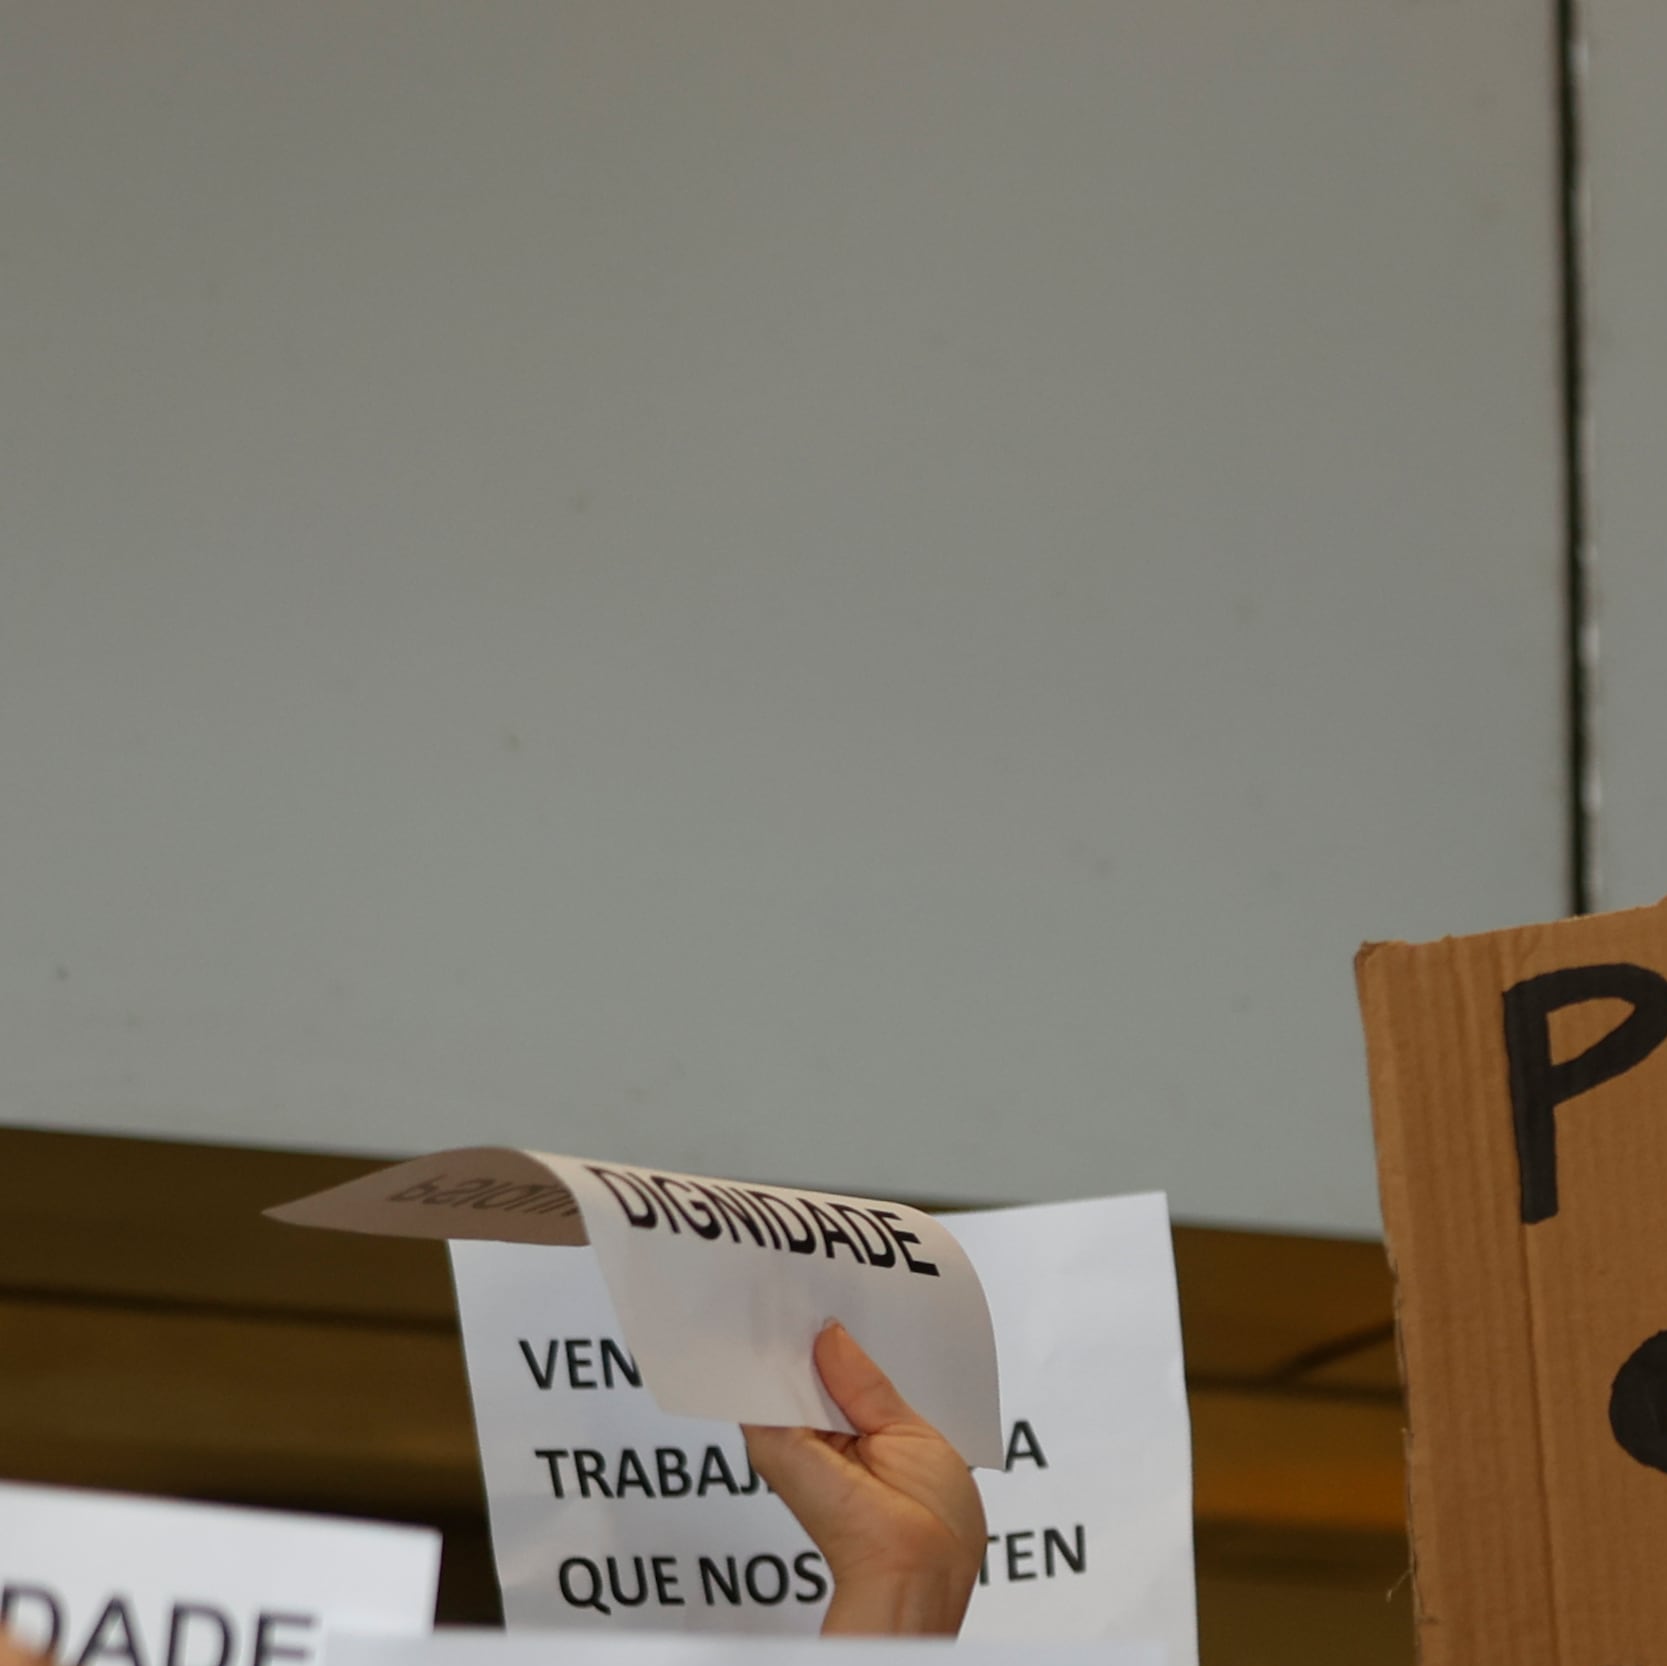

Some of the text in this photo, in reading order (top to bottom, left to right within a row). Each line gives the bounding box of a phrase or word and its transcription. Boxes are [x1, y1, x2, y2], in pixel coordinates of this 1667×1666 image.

[583, 1165, 940, 1276] DIGNIDADE
[518, 1338, 643, 1390] VEN
[535, 1445, 775, 1499] TRABAJ
[558, 1524, 1086, 1615] QUE NOS TEN
